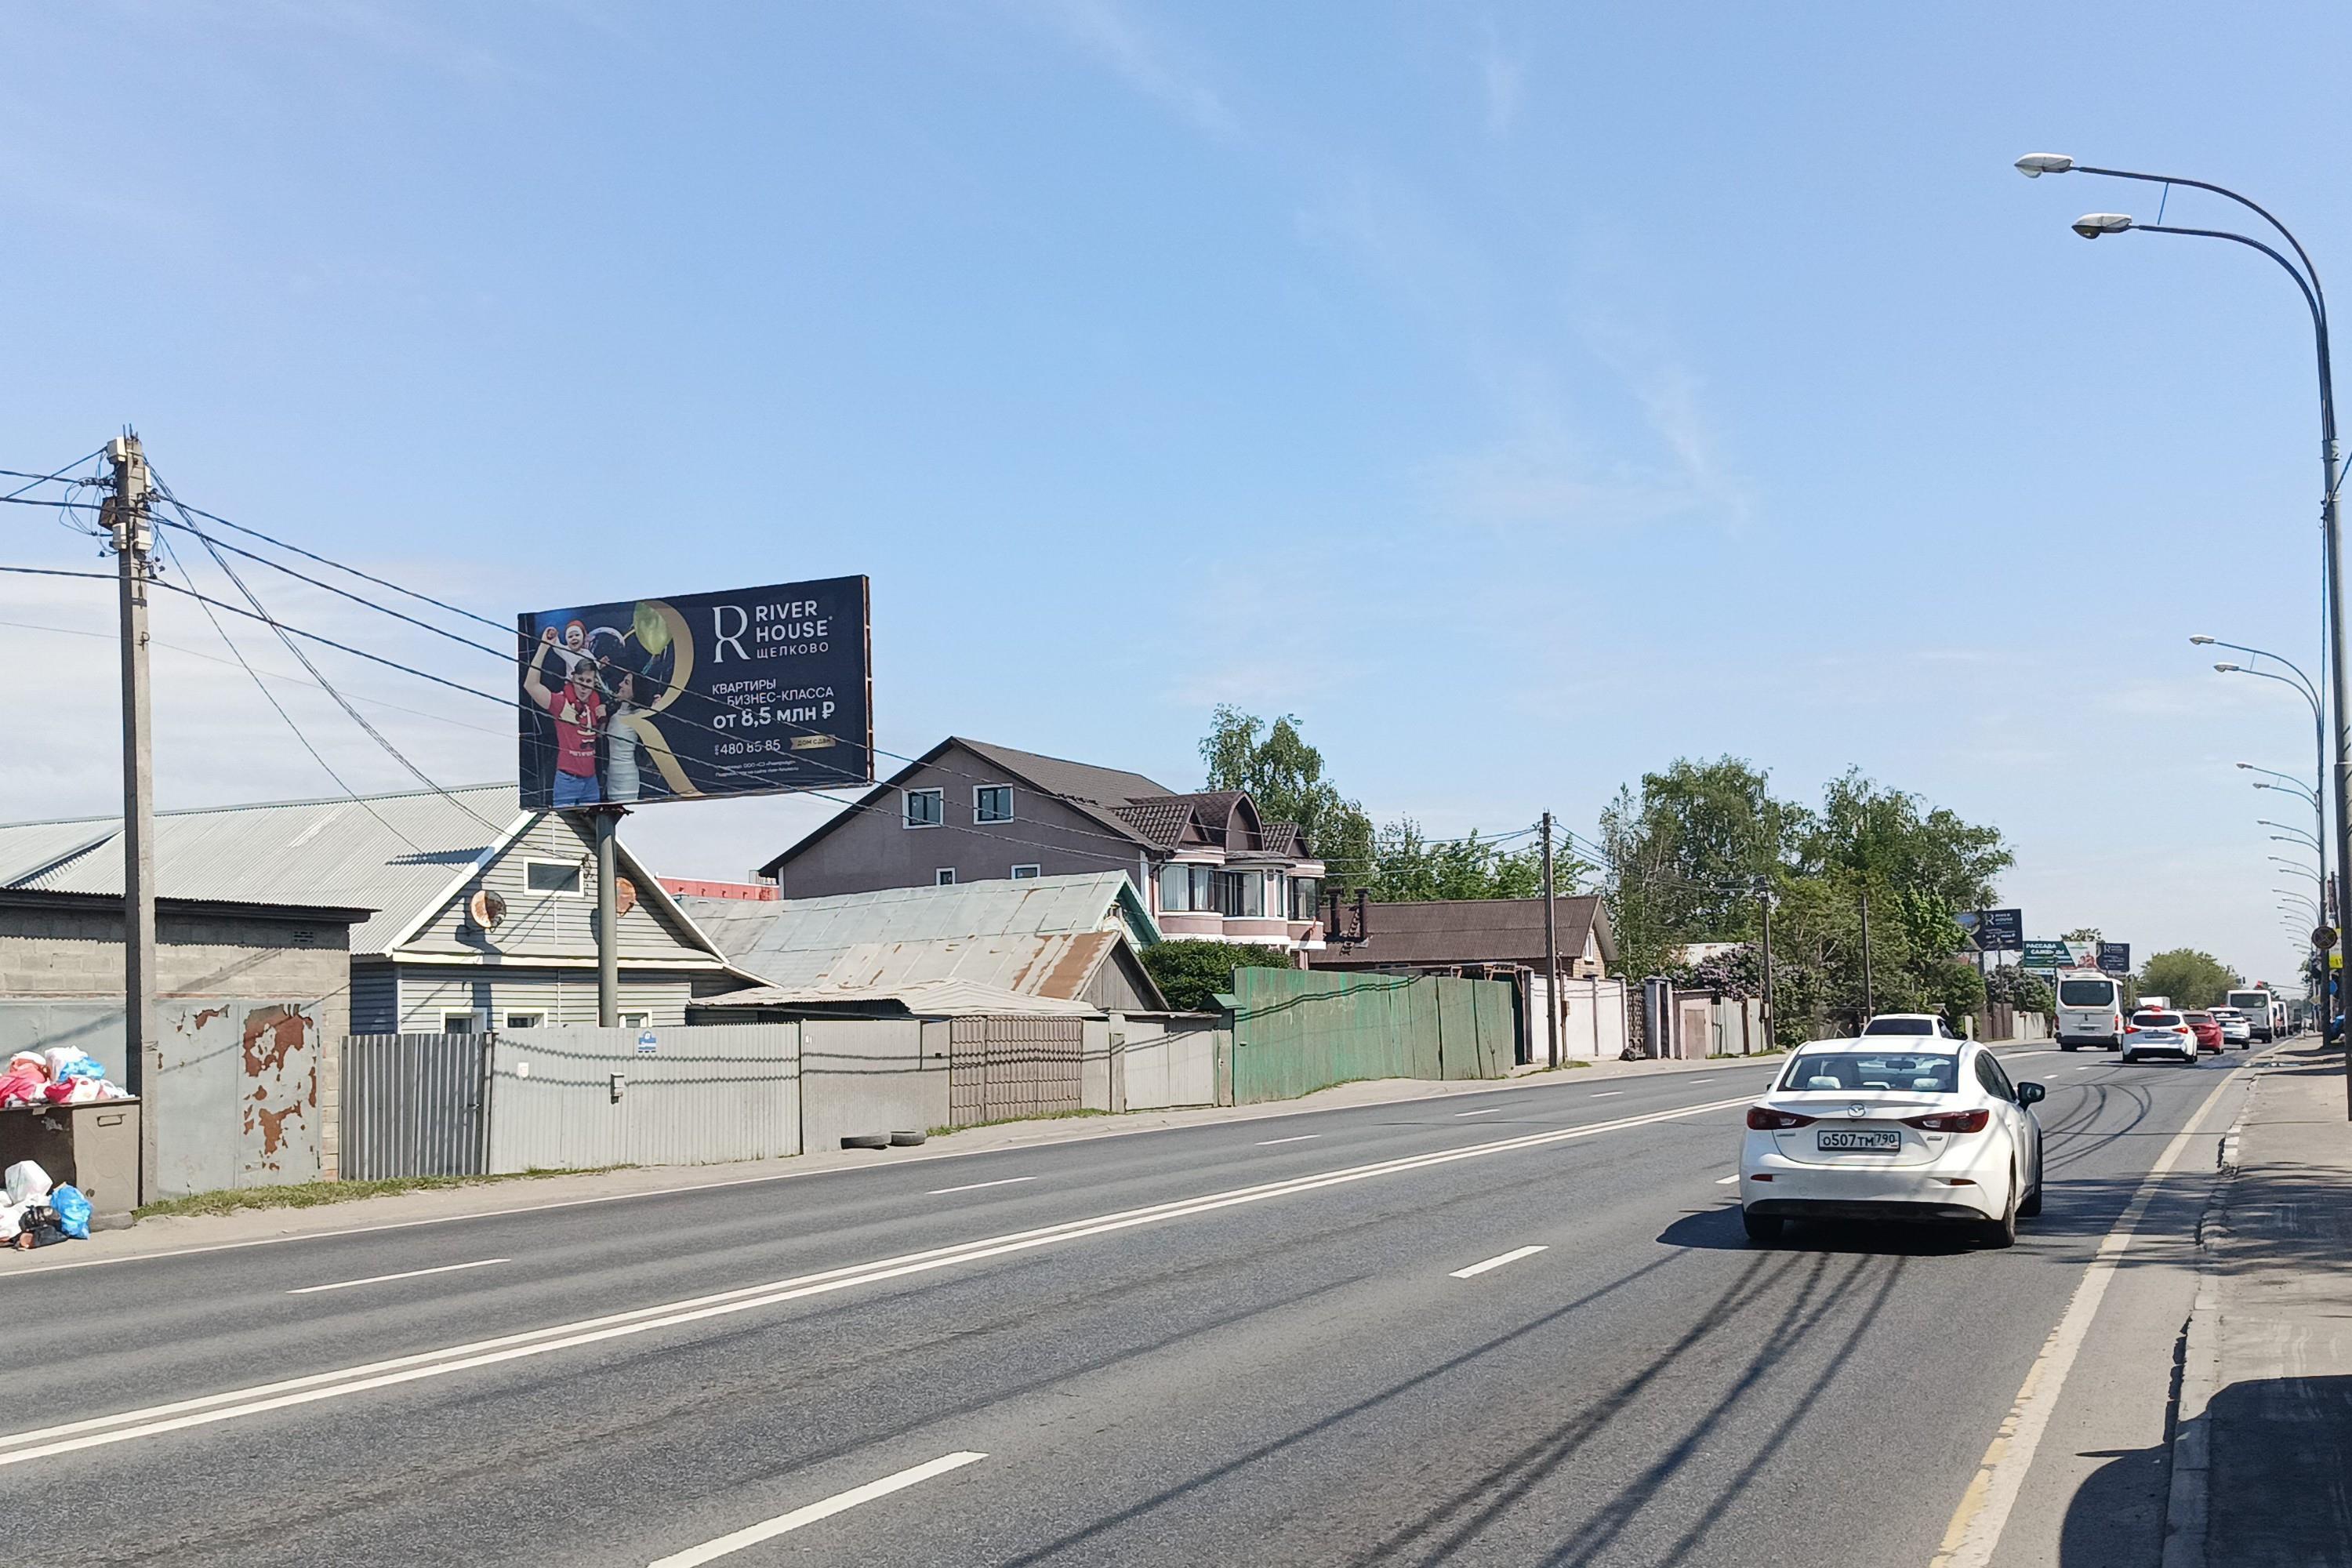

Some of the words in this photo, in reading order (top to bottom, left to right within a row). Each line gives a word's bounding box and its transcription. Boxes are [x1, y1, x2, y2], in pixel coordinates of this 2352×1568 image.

[756, 600, 818, 622] RIVER
[712, 605, 751, 663] R
[756, 619, 829, 643] HOUSE
[757, 641, 829, 659] ЩЕЛКОВО
[712, 678, 776, 695] КВАРТИРЫ
[727, 686, 834, 706] БИЗНЕС-КЛАССА
[741, 706, 771, 728] 8,5
[822, 701, 835, 720] ₽
[720, 742, 744, 755] 480
[746, 740, 763, 753] 85
[765, 739, 781, 751] 85
[1875, 1134, 1896, 1144] 790
